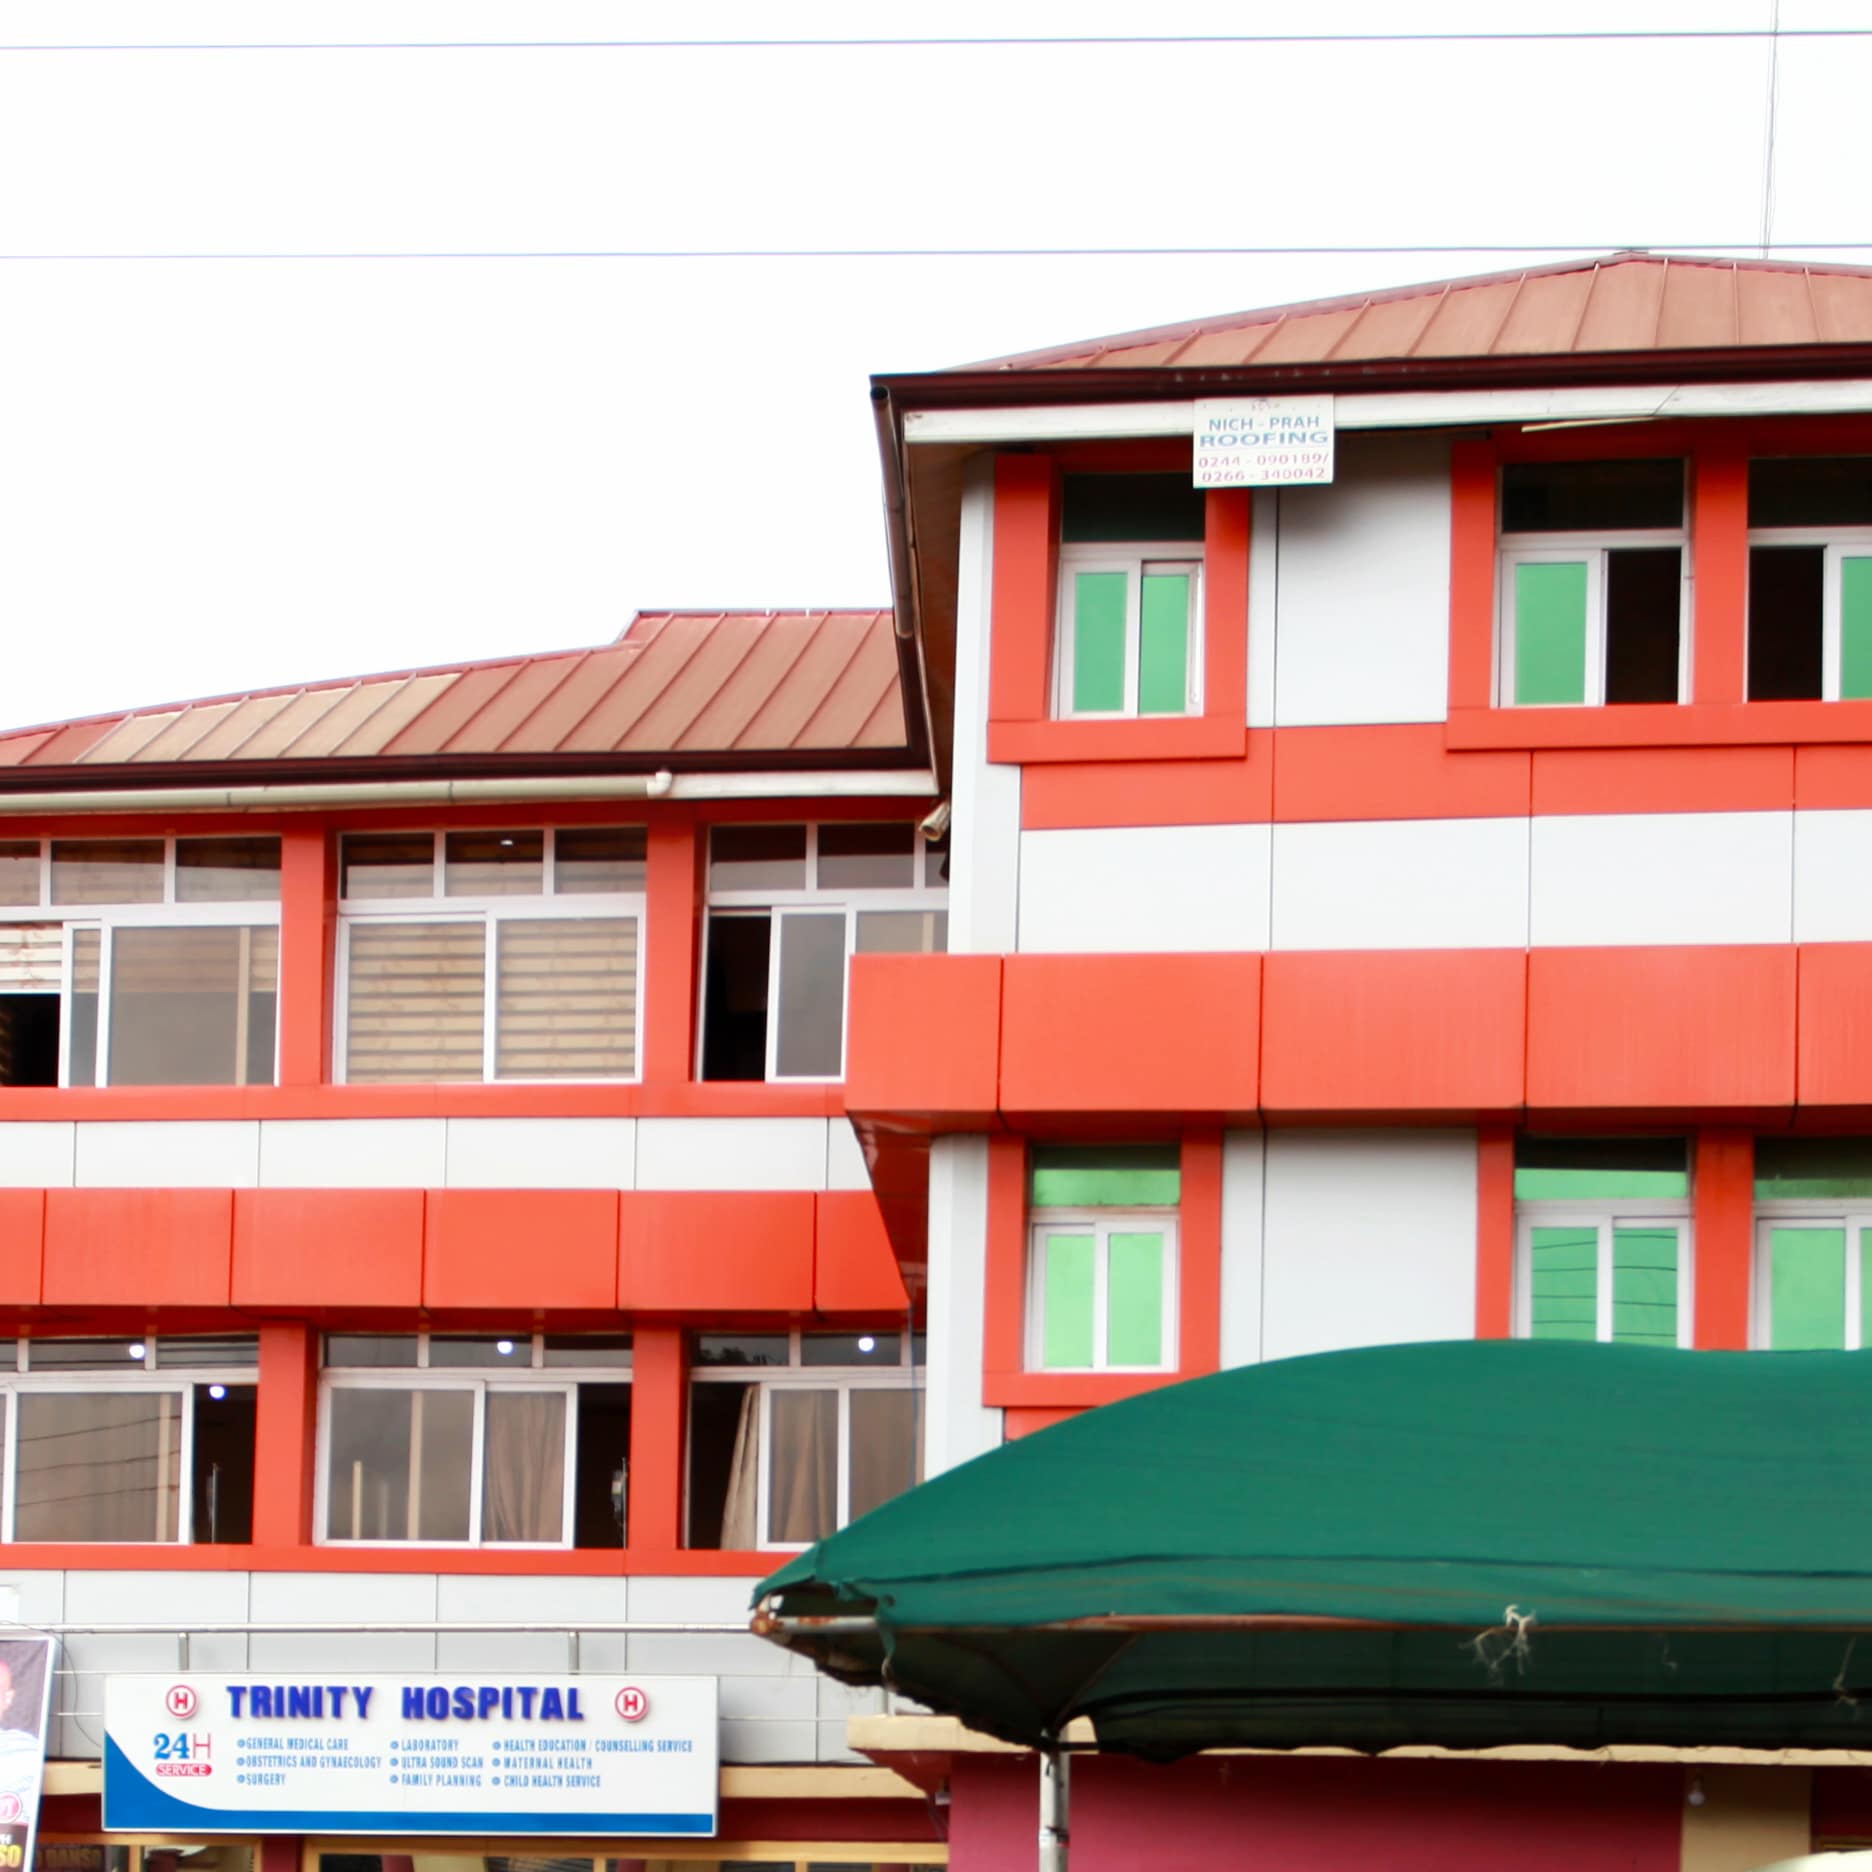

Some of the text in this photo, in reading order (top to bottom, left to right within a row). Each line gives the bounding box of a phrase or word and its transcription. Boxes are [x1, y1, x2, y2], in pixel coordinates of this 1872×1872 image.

[1208, 417, 1254, 431] NICH
[1269, 415, 1320, 430] PRAH
[1199, 431, 1329, 447] ROOFING
[227, 1685, 585, 1721] TRINITY HOSPITAL
[246, 1738, 349, 1751] GENERAL MEDICAL CARE
[401, 1739, 459, 1752] LABORATORY
[504, 1739, 535, 1752] HEALTH
[538, 1739, 587, 1752] EDUCATION
[595, 1740, 654, 1753] COUNSELLING
[657, 1740, 693, 1753] SERVICE
[246, 1756, 382, 1769] OBSTETRICS AND GYNAECOLOGY
[401, 1757, 484, 1769] ULTRA SOUND SCAN
[504, 1757, 592, 1769] MATERNAL HEALTH
[157, 1764, 207, 1777] SERVICE
[246, 1773, 285, 1785] SURGERY
[401, 1774, 482, 1787] FAMILY PLANNING
[504, 1775, 601, 1788] CHILD HEALTH SERVICE
